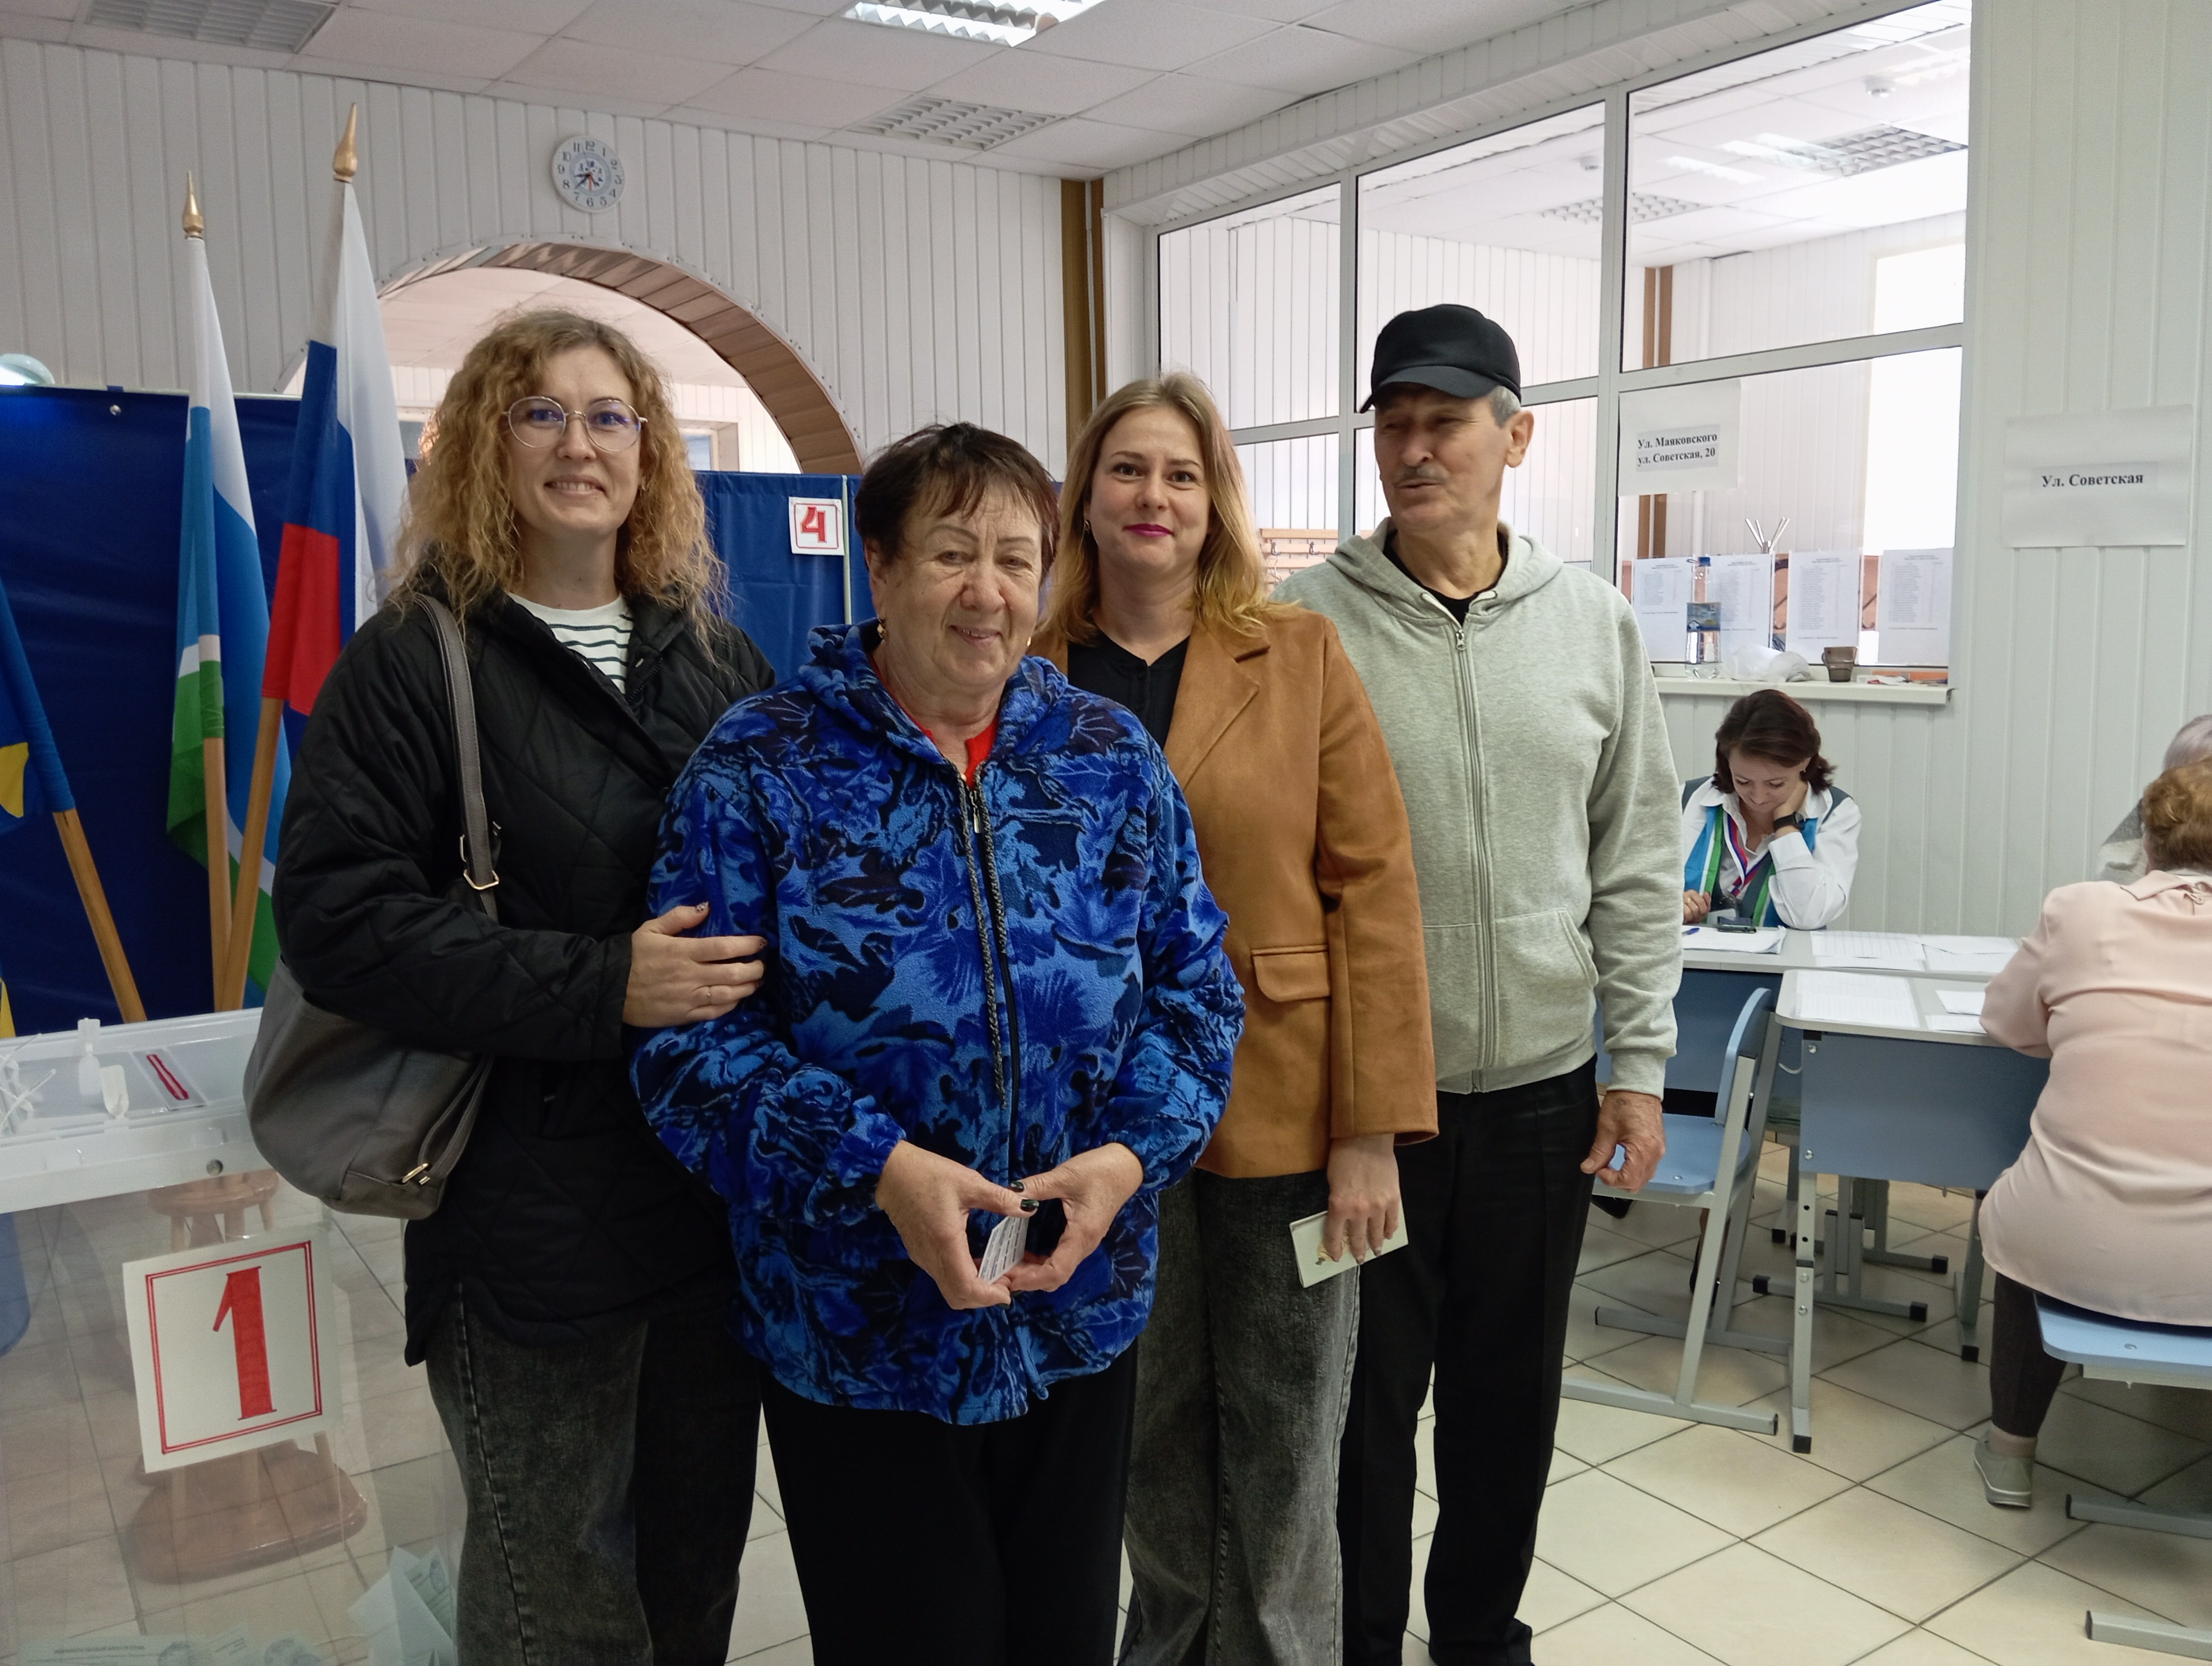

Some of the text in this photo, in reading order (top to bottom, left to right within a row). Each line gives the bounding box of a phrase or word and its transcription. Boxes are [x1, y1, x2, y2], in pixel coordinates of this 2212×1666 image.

[574, 142, 580, 153] 11
[586, 140, 595, 151] 12
[563, 151, 571, 162] 10
[602, 148, 605, 157] 1
[558, 164, 565, 174] 9
[611, 159, 618, 170] 2
[563, 180, 570, 189] 8
[614, 175, 622, 185] 3
[574, 191, 580, 201] 7
[609, 189, 616, 198] 4
[587, 197, 594, 207] 6
[600, 196, 607, 206] 5
[1638, 433, 1718, 449] Ул. Маяковского
[1637, 447, 1715, 466] ул. Советская, 20
[2041, 473, 2144, 488] Ул. Советская
[801, 506, 827, 543] 4
[213, 1266, 277, 1421] 1
